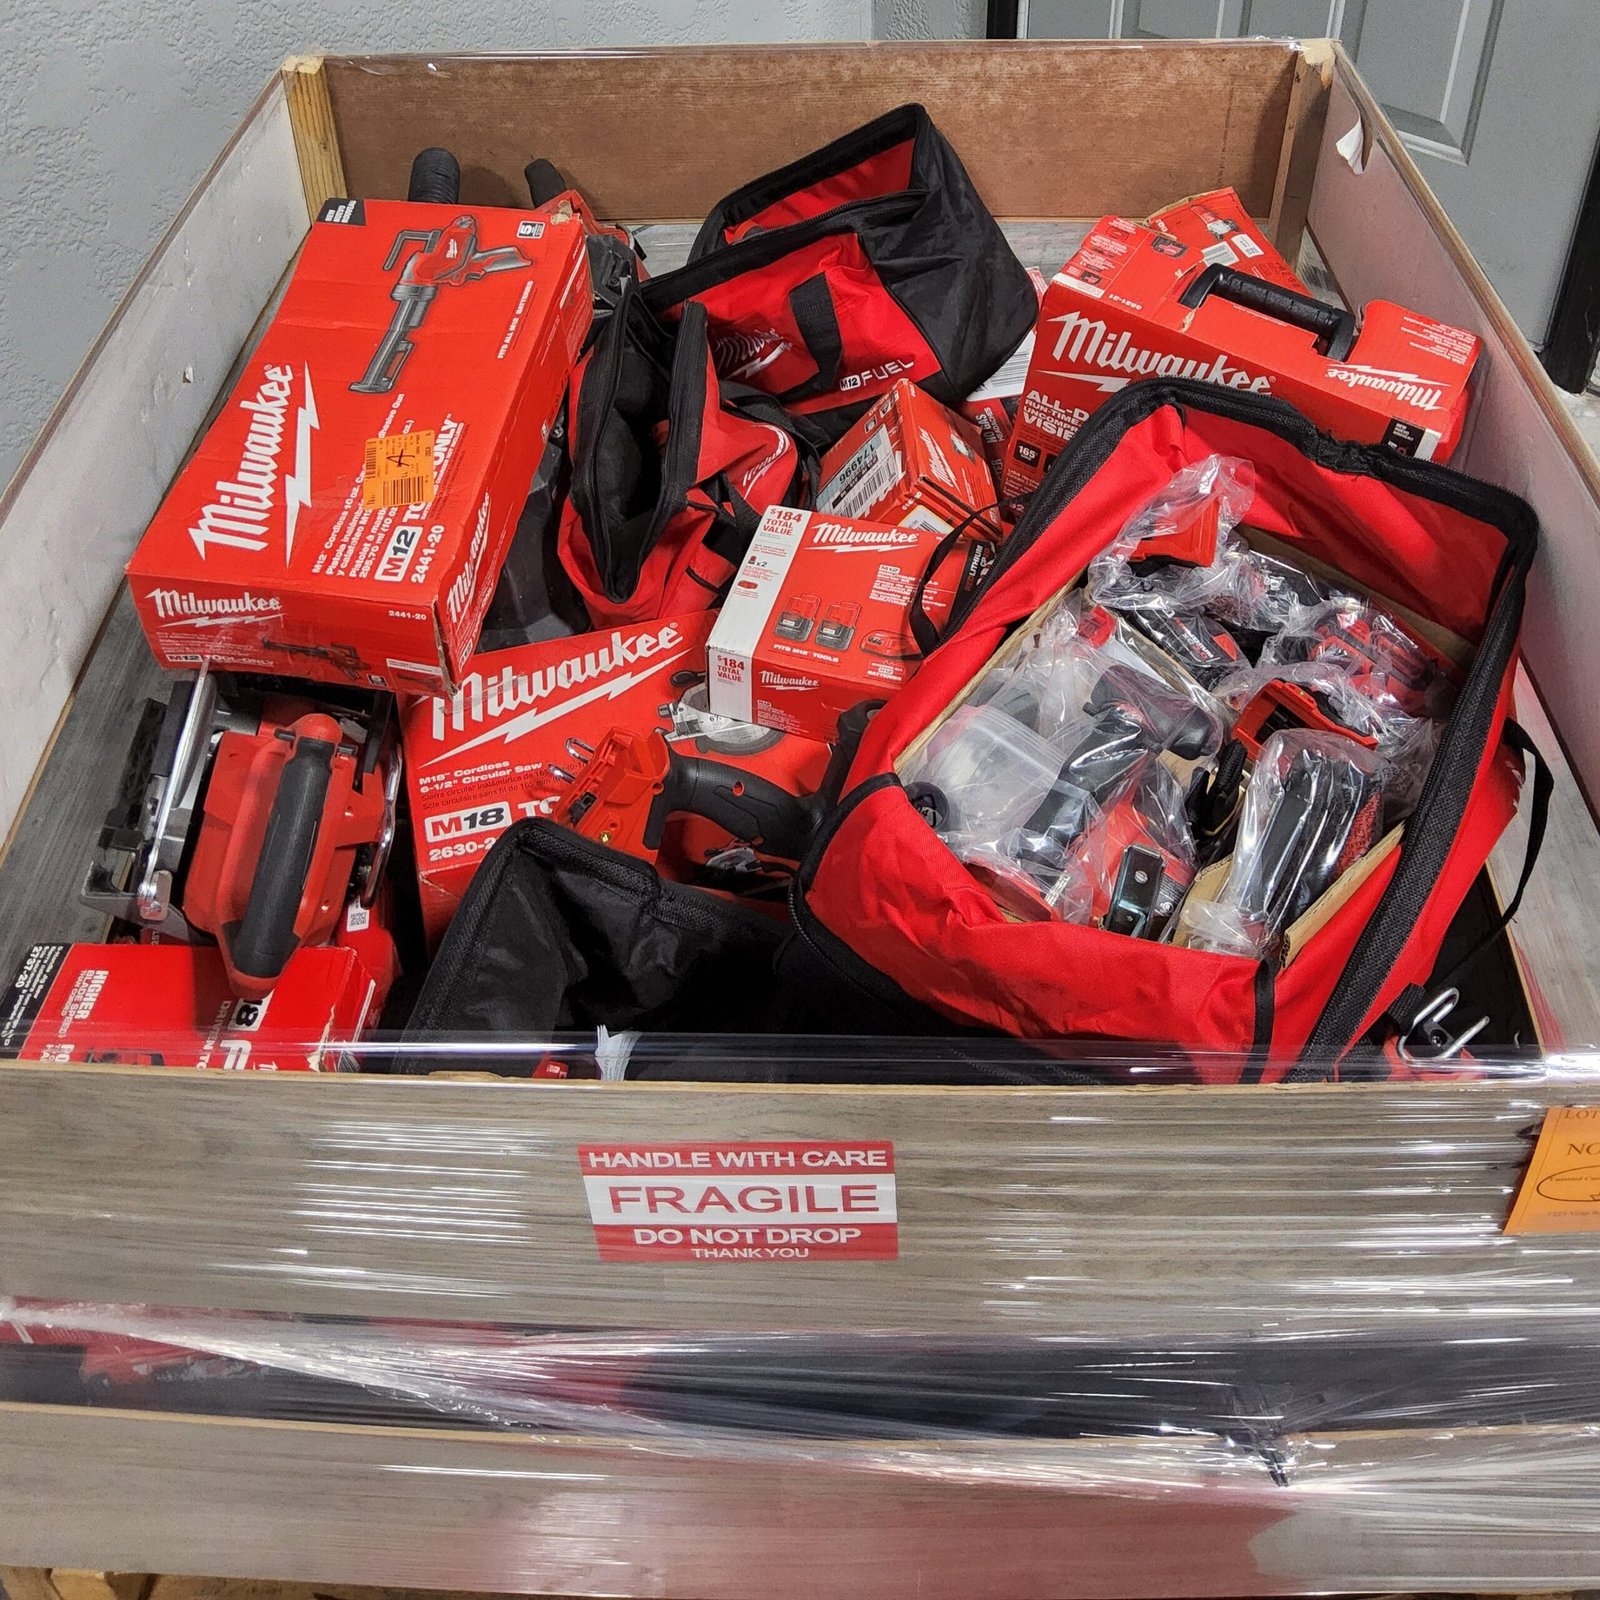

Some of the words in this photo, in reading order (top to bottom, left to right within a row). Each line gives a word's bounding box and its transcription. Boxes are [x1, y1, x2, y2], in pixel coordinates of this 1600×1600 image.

[520, 224, 531, 235] 5
[1046, 311, 1274, 394] Milwaukee
[840, 377, 860, 390] M12
[862, 359, 915, 387] FUEL
[1327, 368, 1449, 411] Milwaukee
[984, 407, 1005, 442] HEADACHES
[187, 361, 293, 562] Milwaukee
[324, 509, 348, 550] Cordless
[344, 498, 353, 511] 10
[377, 409, 397, 439] dhesive
[392, 393, 405, 410] Gun
[386, 448, 415, 468] A
[839, 443, 877, 486] 174996
[766, 518, 794, 529] TOTAL
[770, 508, 804, 523] $184
[326, 543, 342, 576] Pistola
[341, 499, 365, 544] inalámbri
[349, 540, 370, 578] Pistolet
[370, 505, 388, 534] masti
[762, 524, 794, 536] VALUE
[809, 522, 920, 546] Milwaukee
[340, 528, 362, 570] calafateo
[358, 546, 380, 579] 295,70
[380, 529, 416, 578] M12
[410, 525, 444, 584] 2441-20
[145, 588, 282, 618] Milwaukee
[388, 610, 428, 621] 2441-20
[717, 656, 745, 670] $184
[718, 664, 742, 676] TOTAL
[812, 652, 840, 663] TOOLS
[430, 624, 685, 741] Milwaukee
[718, 672, 742, 683] VALUE
[758, 670, 820, 686] Milwaukee
[418, 774, 446, 785] M18
[454, 761, 510, 778] Cordless
[462, 769, 512, 784] Circular
[514, 762, 542, 774] Saw
[421, 791, 445, 802] Sierra
[446, 786, 476, 798] circular
[442, 794, 478, 806] circulaire
[430, 807, 504, 837] M18
[429, 837, 496, 862] 2630-2
[15, 946, 42, 988] 2737-20
[46, 946, 64, 973] D-Handle
[74, 970, 95, 1002] BLADE
[75, 970, 88, 988] THAN
[60, 988, 78, 1017] CORDED
[74, 970, 110, 1020] HIGHER
[203, 1000, 232, 1050] DRIVEN
[236, 999, 264, 1026] 18
[589, 1152, 712, 1169] HANDLE
[716, 1151, 794, 1168] WITH
[802, 1150, 888, 1167] CARE
[608, 1184, 880, 1214] FRAGILE
[634, 1228, 683, 1246] DO
[690, 1228, 762, 1245] NOT
[766, 1228, 862, 1244] DROP
[690, 1248, 767, 1259] THANK
[768, 1248, 810, 1259] YOU
